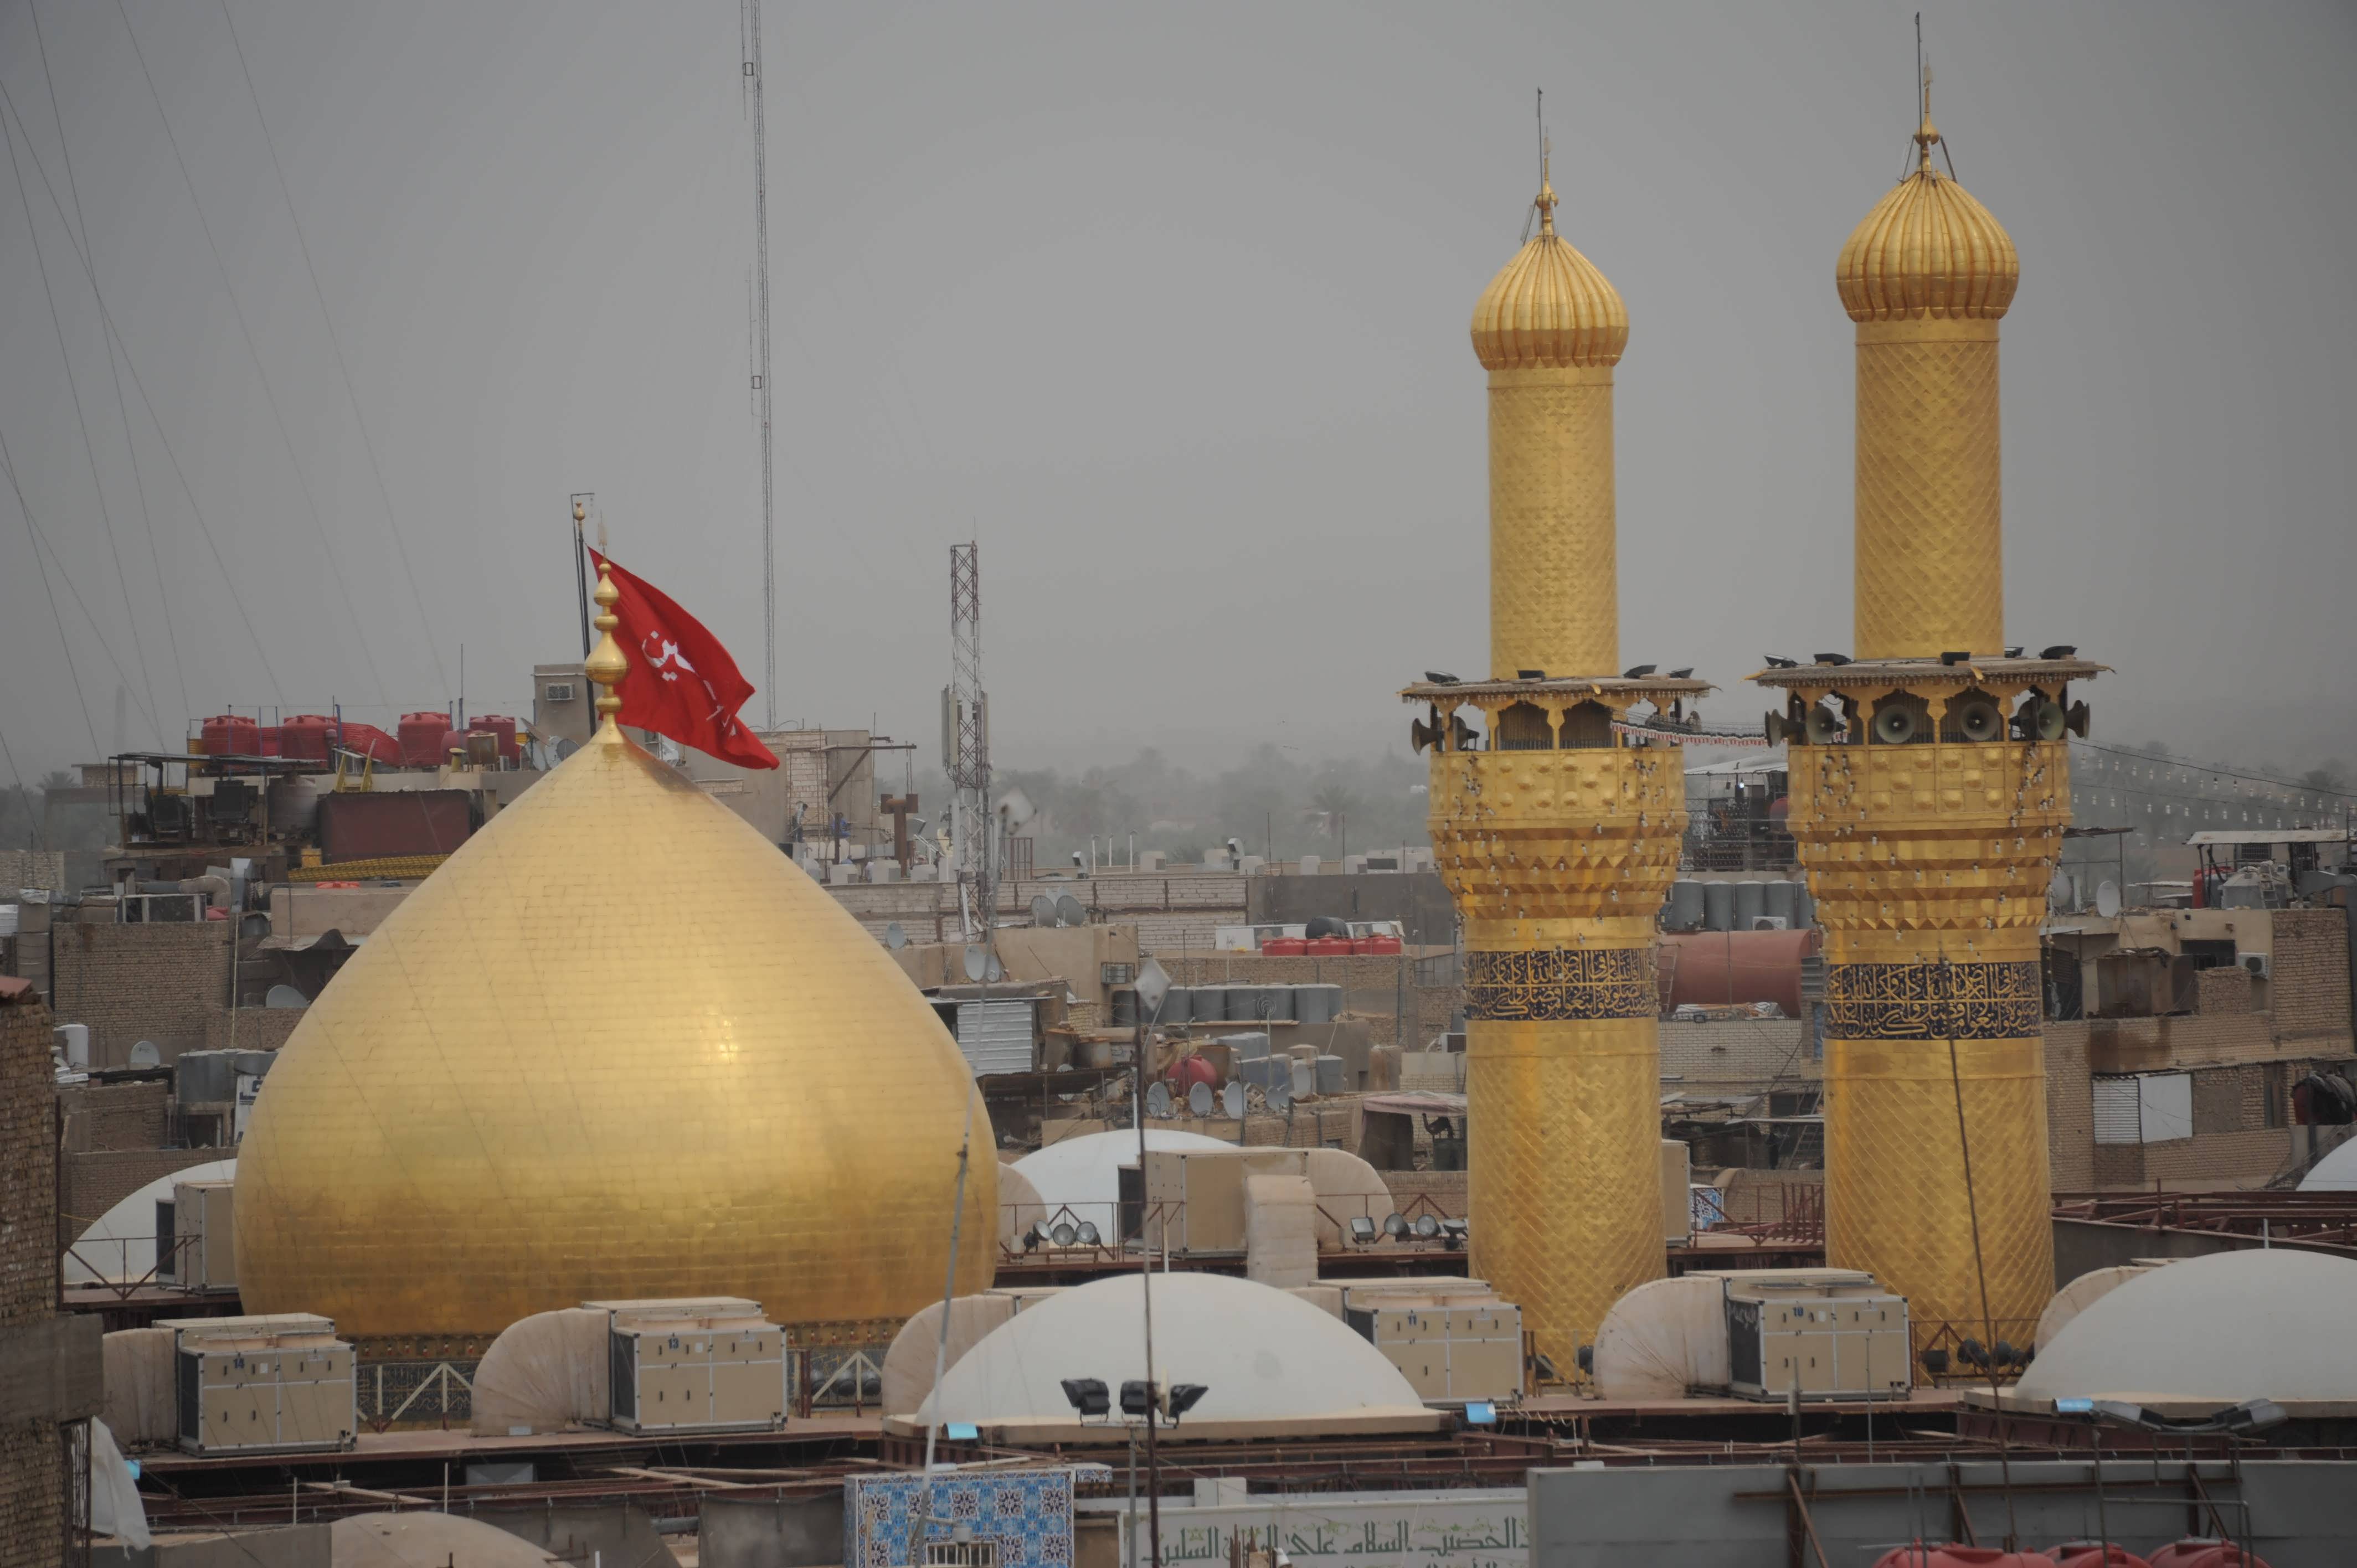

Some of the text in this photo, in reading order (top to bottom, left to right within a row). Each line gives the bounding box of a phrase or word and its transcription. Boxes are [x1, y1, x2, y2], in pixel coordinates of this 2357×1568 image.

[233, 1358, 244, 1369] 14
[1285, 1526, 1338, 1555] على
[1344, 1519, 1413, 1554] السلام
